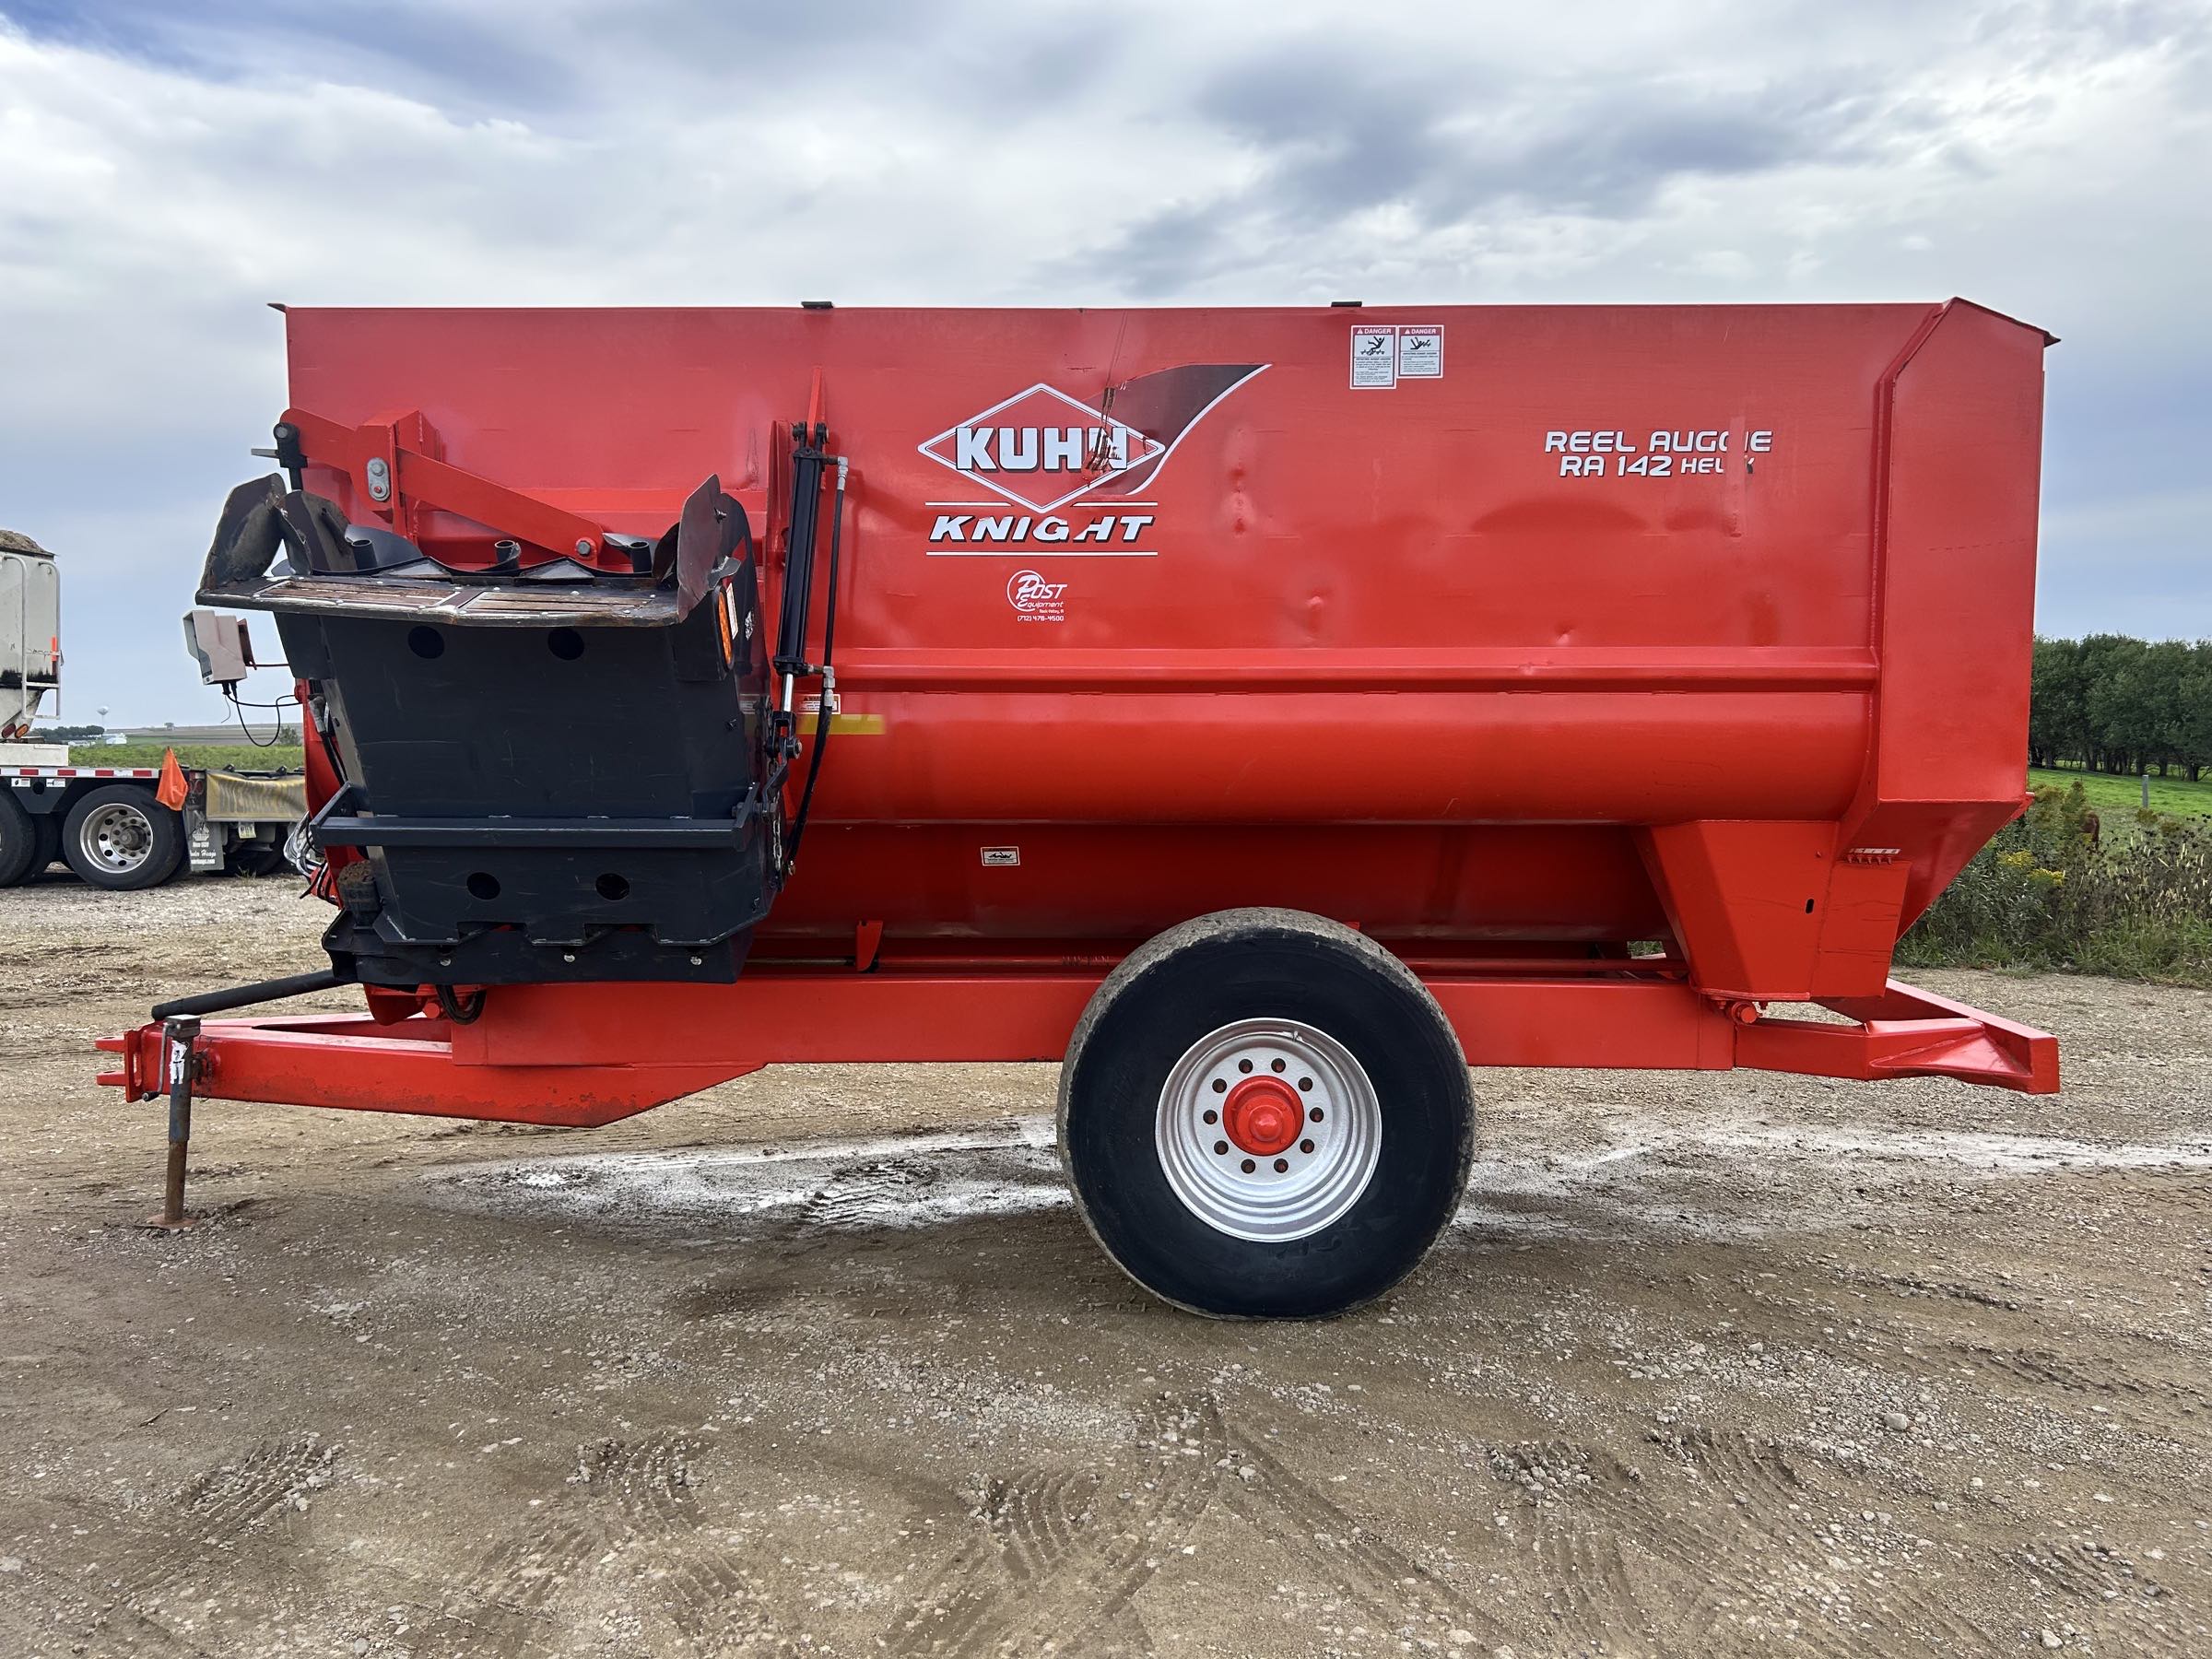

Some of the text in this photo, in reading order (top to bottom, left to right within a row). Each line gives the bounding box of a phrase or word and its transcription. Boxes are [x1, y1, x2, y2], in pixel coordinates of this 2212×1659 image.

[956, 427, 1128, 471] KUHN
[1545, 430, 1773, 453] REEL AUGE
[1559, 455, 1606, 477] RA
[1618, 455, 1672, 477] 142
[929, 515, 1155, 543] KNIGHT
